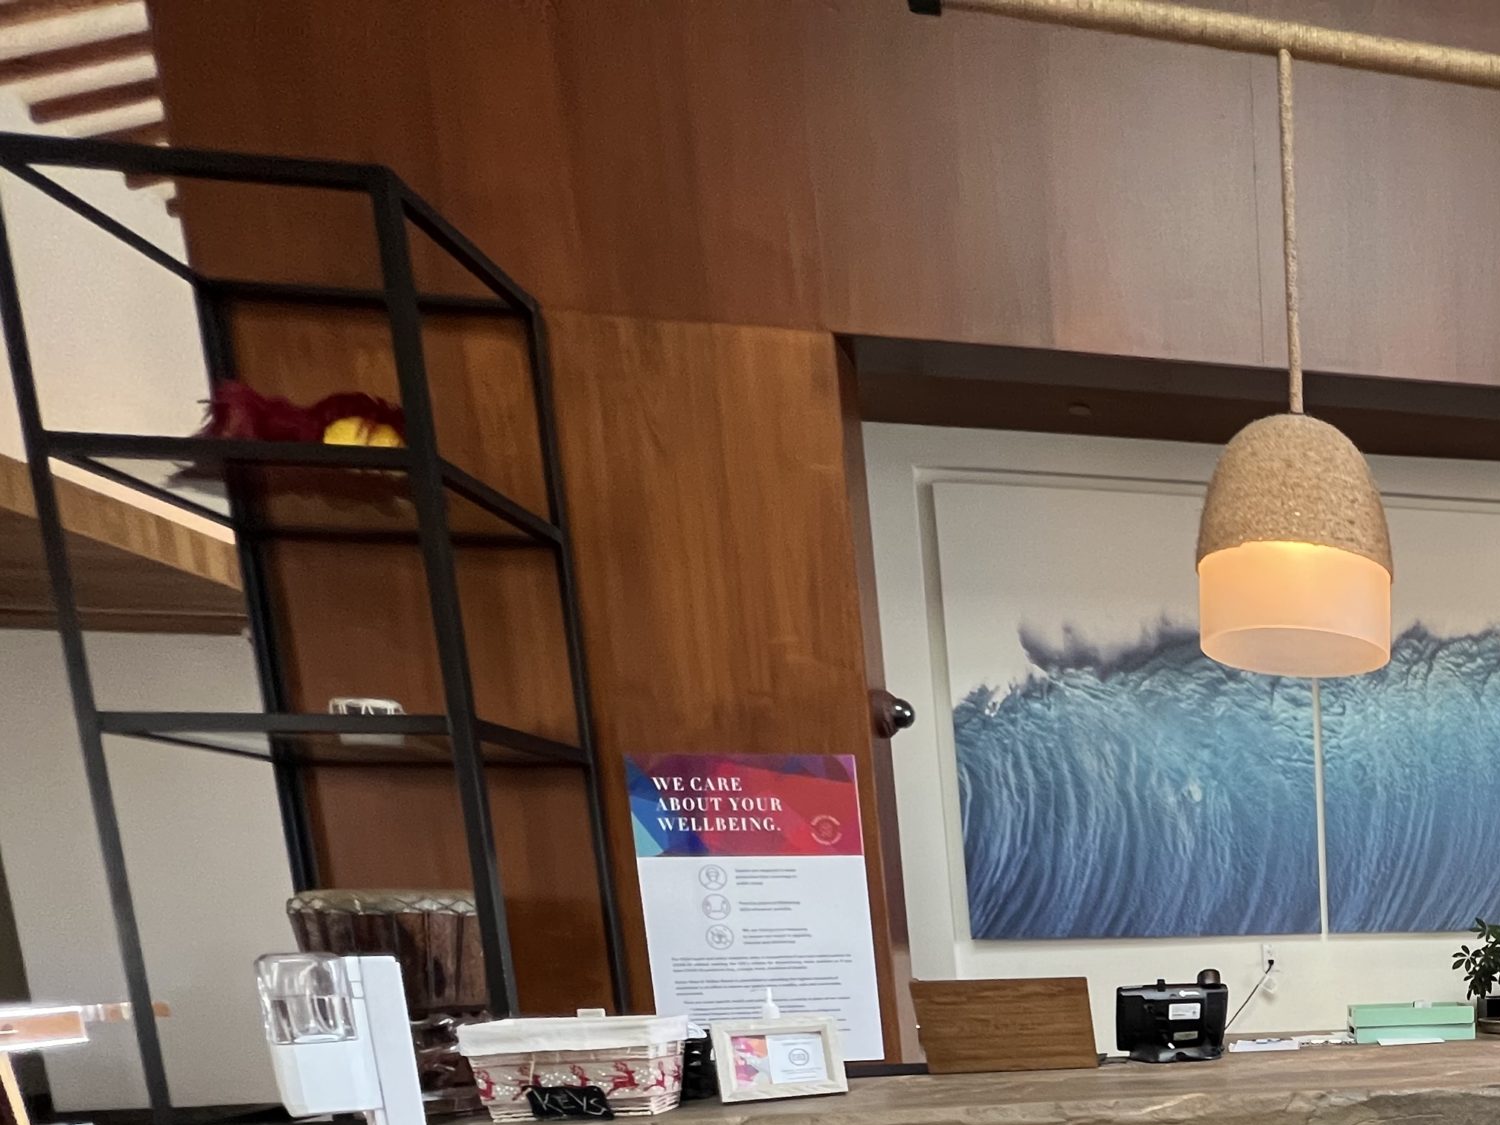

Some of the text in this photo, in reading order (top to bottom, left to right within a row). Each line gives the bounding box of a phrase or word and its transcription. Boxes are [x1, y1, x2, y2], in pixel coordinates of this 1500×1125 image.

[651, 777, 742, 791] WE CARE
[656, 797, 782, 811] ABOUT YOUR
[657, 817, 781, 831] WELLBEING.
[532, 1089, 607, 1116] KEYS
